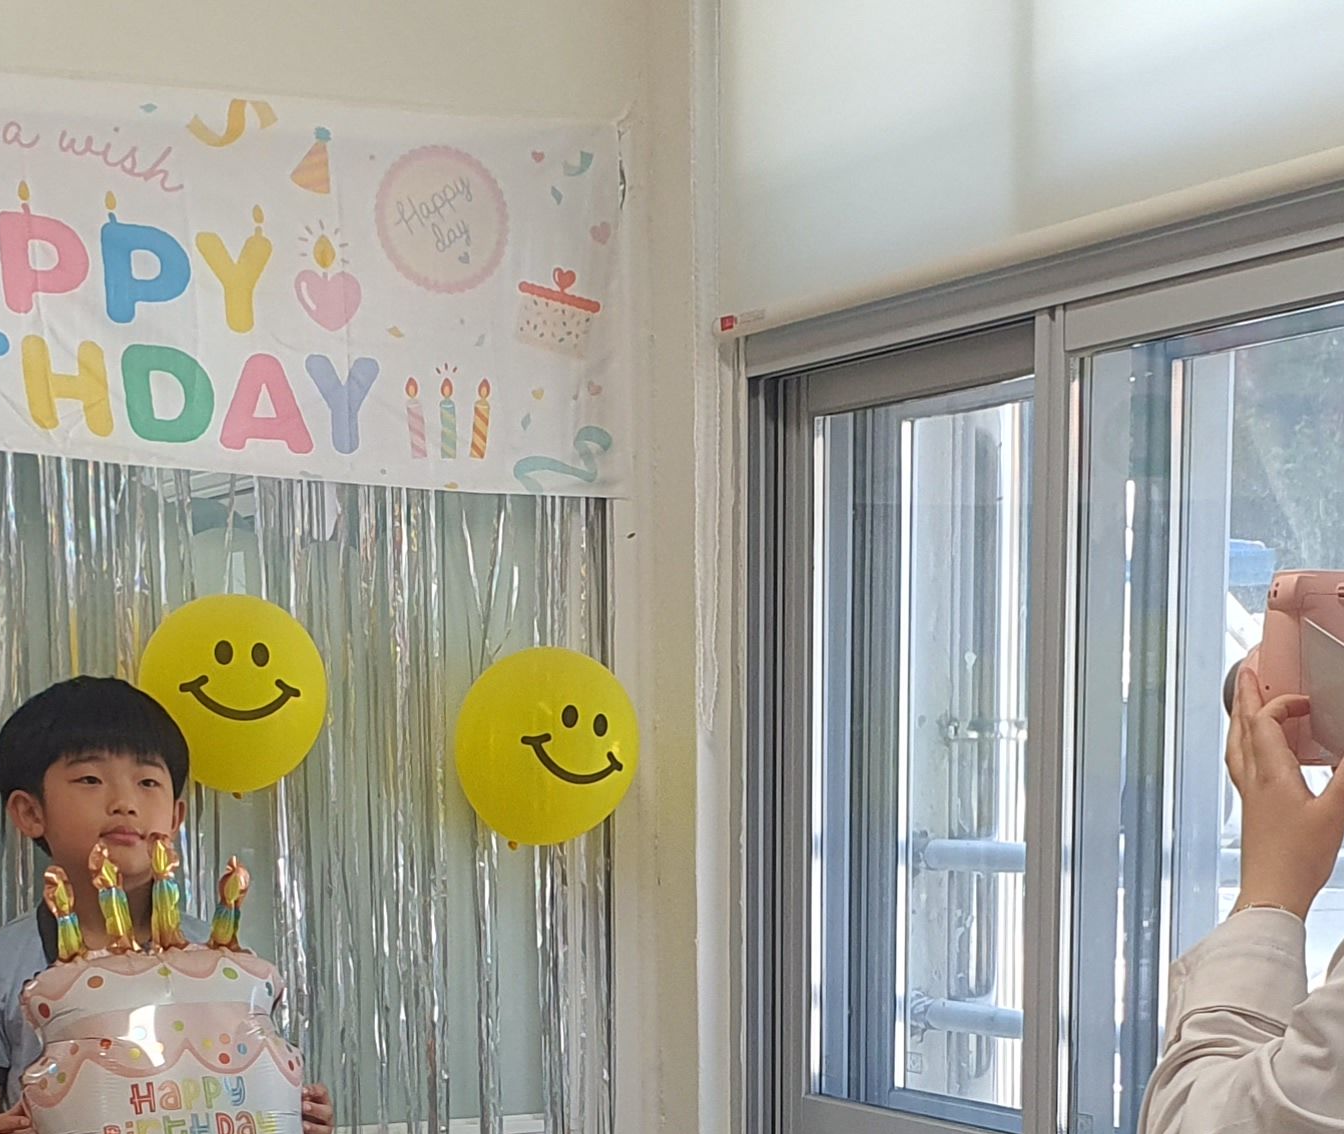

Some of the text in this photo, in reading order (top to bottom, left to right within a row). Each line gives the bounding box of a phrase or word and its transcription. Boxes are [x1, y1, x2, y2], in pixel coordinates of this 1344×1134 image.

[2, 120, 40, 149] a
[58, 126, 184, 192] wish
[394, 176, 473, 236] Happy
[431, 219, 472, 253] day
